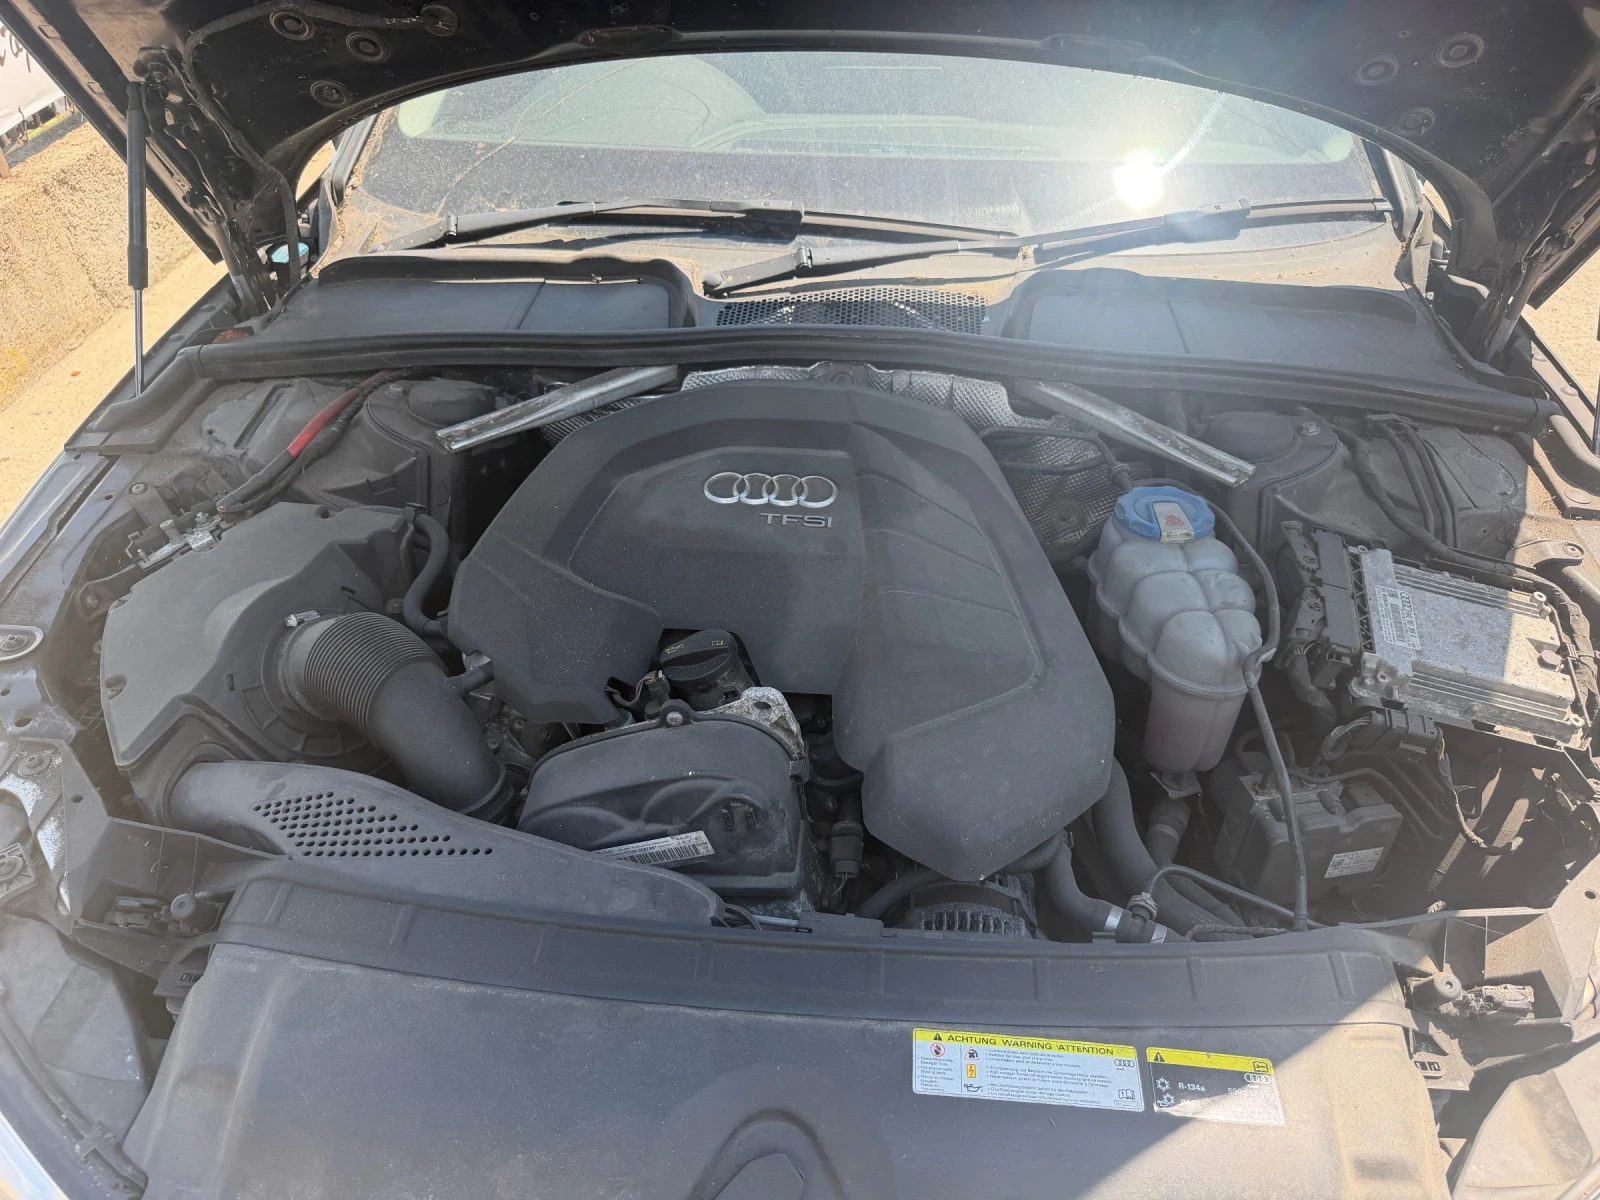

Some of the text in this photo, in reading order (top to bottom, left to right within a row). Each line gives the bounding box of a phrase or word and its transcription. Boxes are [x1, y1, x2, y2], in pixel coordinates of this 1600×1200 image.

[760, 512, 833, 528] TFSI
[947, 1034, 997, 1045] ACHTUNG
[1002, 1039, 1052, 1050] WARNING
[1058, 1044, 1114, 1055] ATTENTION
[1178, 1083, 1206, 1092] R-134a
